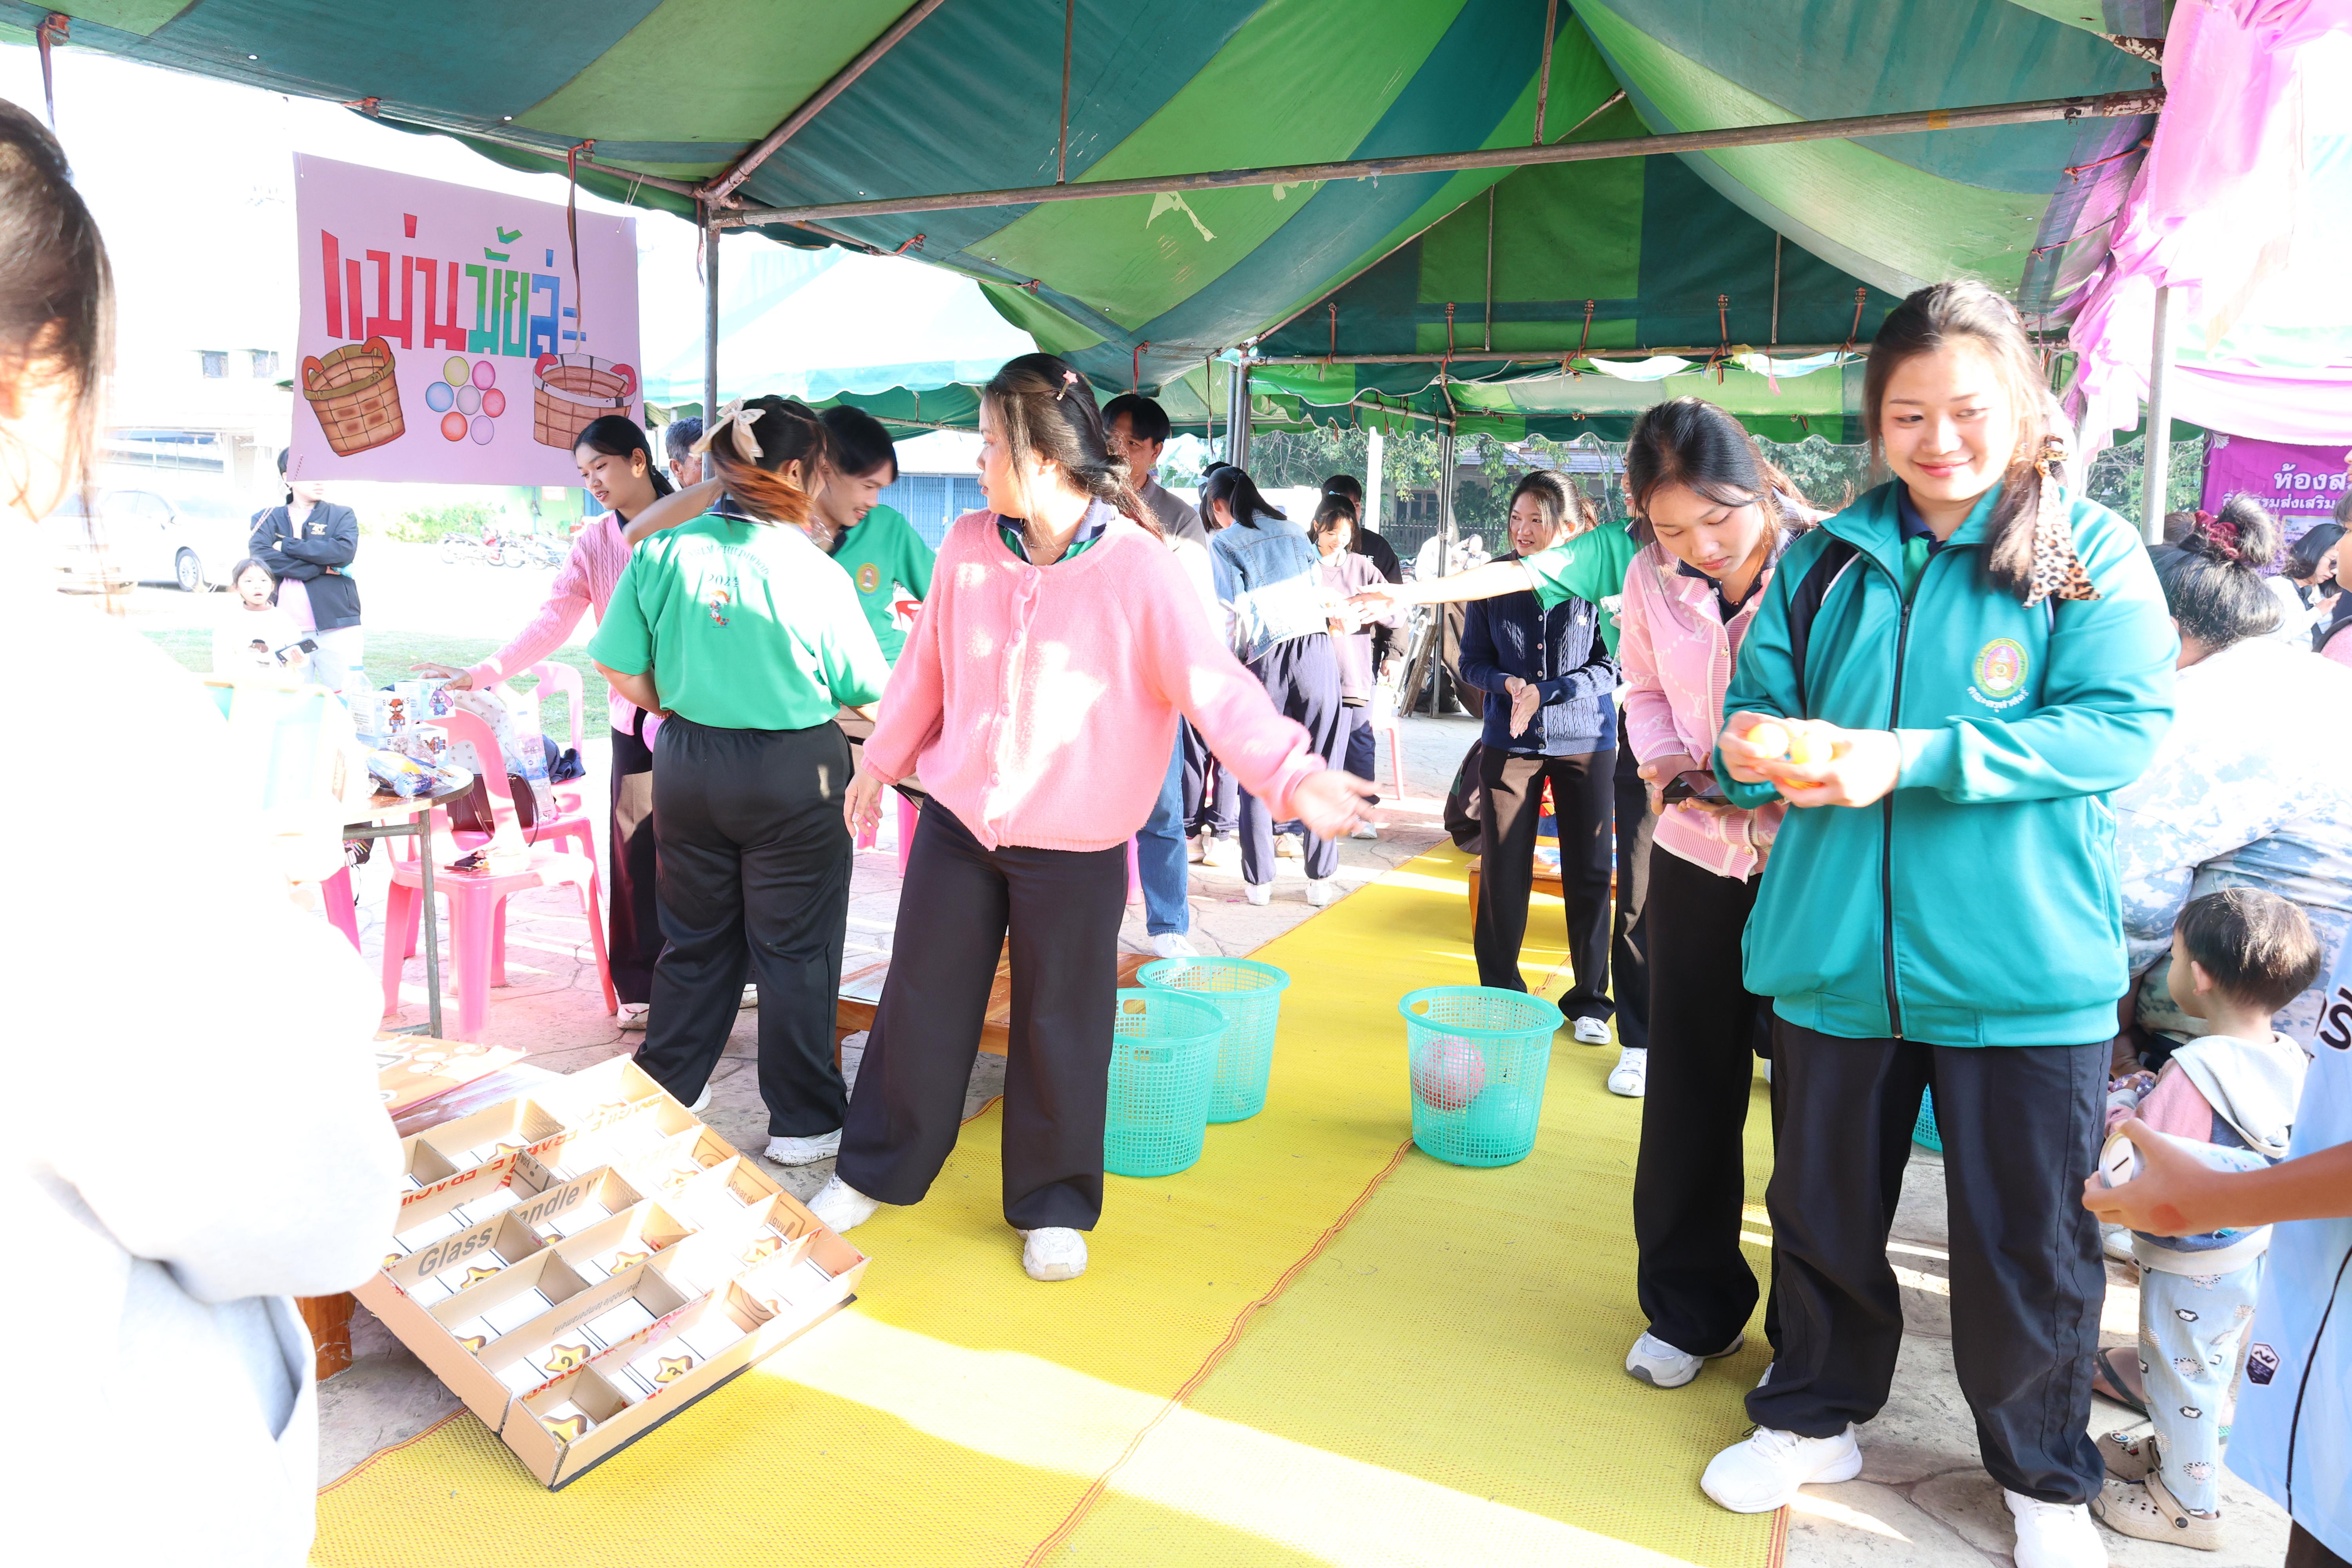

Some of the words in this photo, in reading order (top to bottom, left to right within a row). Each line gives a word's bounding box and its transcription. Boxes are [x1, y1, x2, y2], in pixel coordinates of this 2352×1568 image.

[2274, 463, 2352, 490] ห้องส
[680, 545, 713, 562] ARLY
[383, 697, 410, 706] BLKS
[418, 1227, 493, 1277] Glass
[518, 1185, 580, 1224] andle
[603, 1289, 625, 1306] noble
[552, 1300, 603, 1336] temperament
